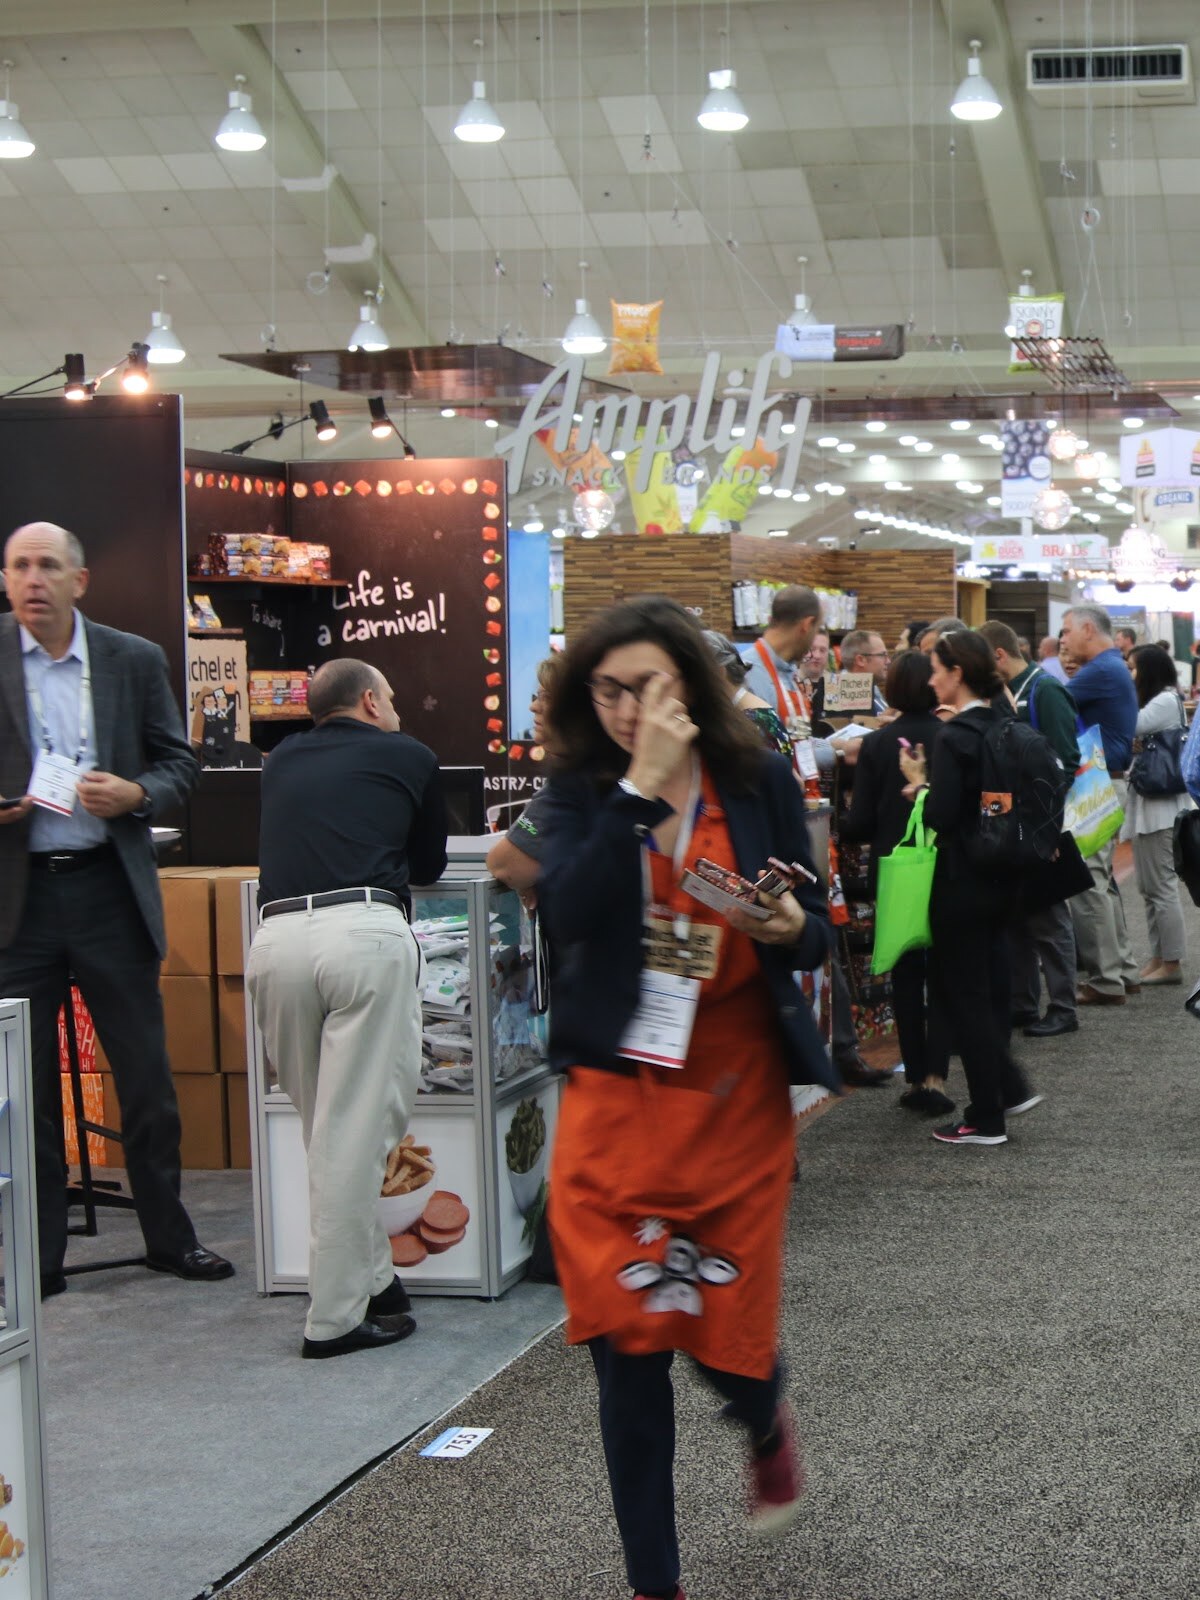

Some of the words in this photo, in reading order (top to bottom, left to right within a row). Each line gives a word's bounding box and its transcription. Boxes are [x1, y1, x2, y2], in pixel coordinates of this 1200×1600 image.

[494, 350, 812, 495] Amplify
[531, 466, 624, 488] SNACK
[662, 463, 773, 486] BRANDS
[332, 570, 386, 610] Life
[392, 577, 415, 601] is
[251, 603, 262, 622] To
[261, 607, 283, 631] share
[317, 624, 332, 646] a
[342, 592, 447, 642] carnival!
[188, 656, 221, 682] ichel
[224, 657, 238, 680] et
[840, 690, 871, 701] Augustin
[484, 776, 548, 791] ASTRY-C
[81, 1058, 91, 1072] Hi
[444, 1434, 478, 1450] 755
